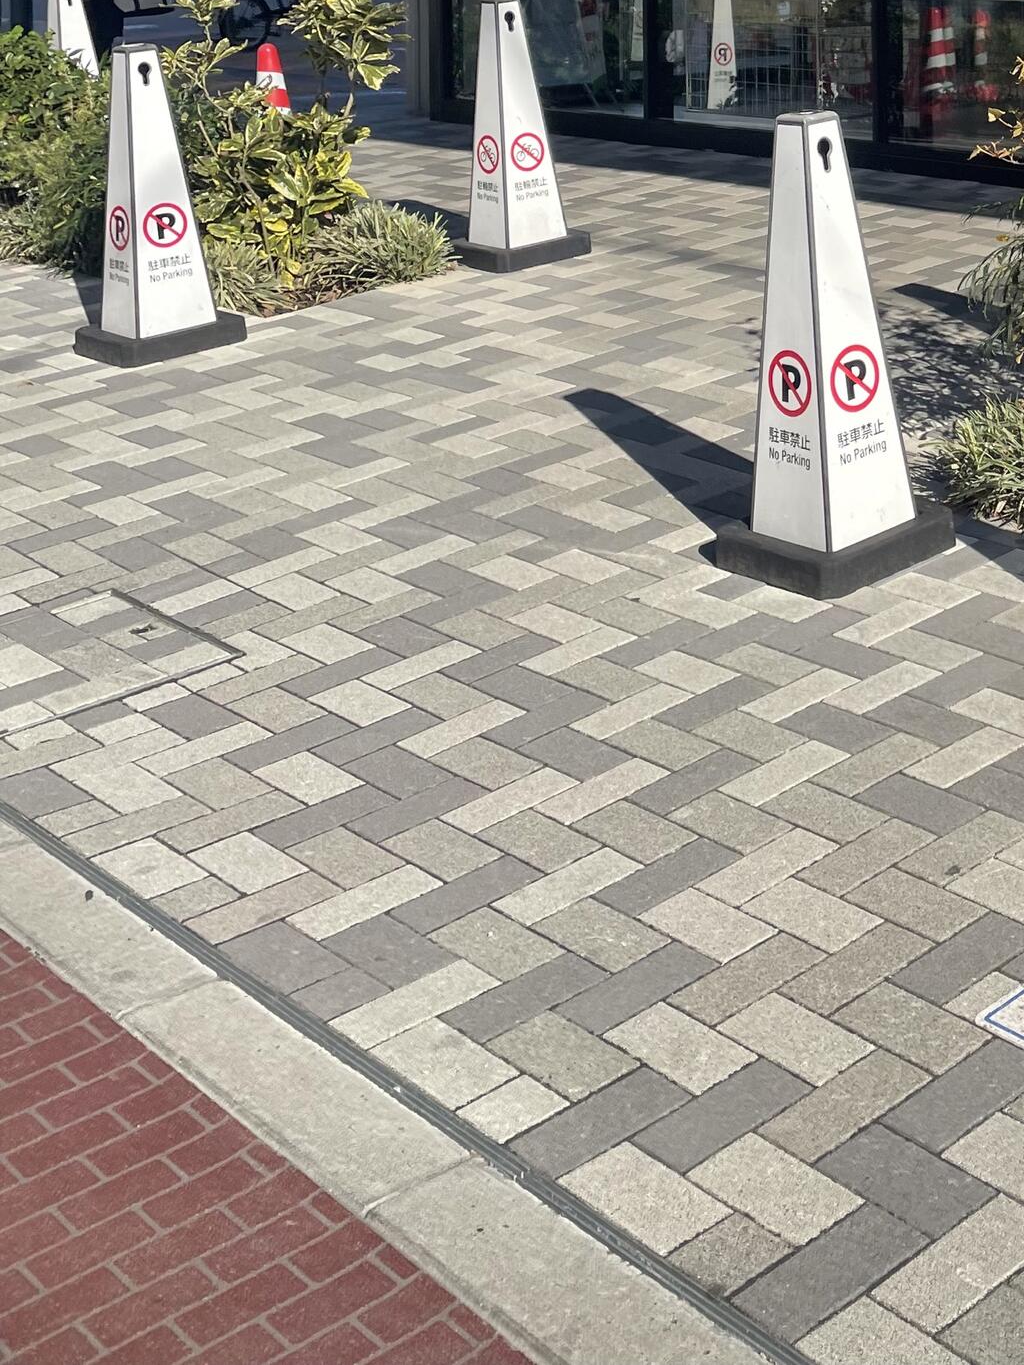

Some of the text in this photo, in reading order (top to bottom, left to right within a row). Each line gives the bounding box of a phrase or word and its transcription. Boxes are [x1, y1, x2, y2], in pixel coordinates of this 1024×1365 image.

[148, 253, 192, 272] 駐車禁止
[149, 267, 194, 284] No Parking
[768, 426, 811, 452] 駐車禁止
[837, 418, 886, 449] 駐車禁止
[769, 447, 812, 471] No Parking
[839, 439, 888, 467] No Parking
